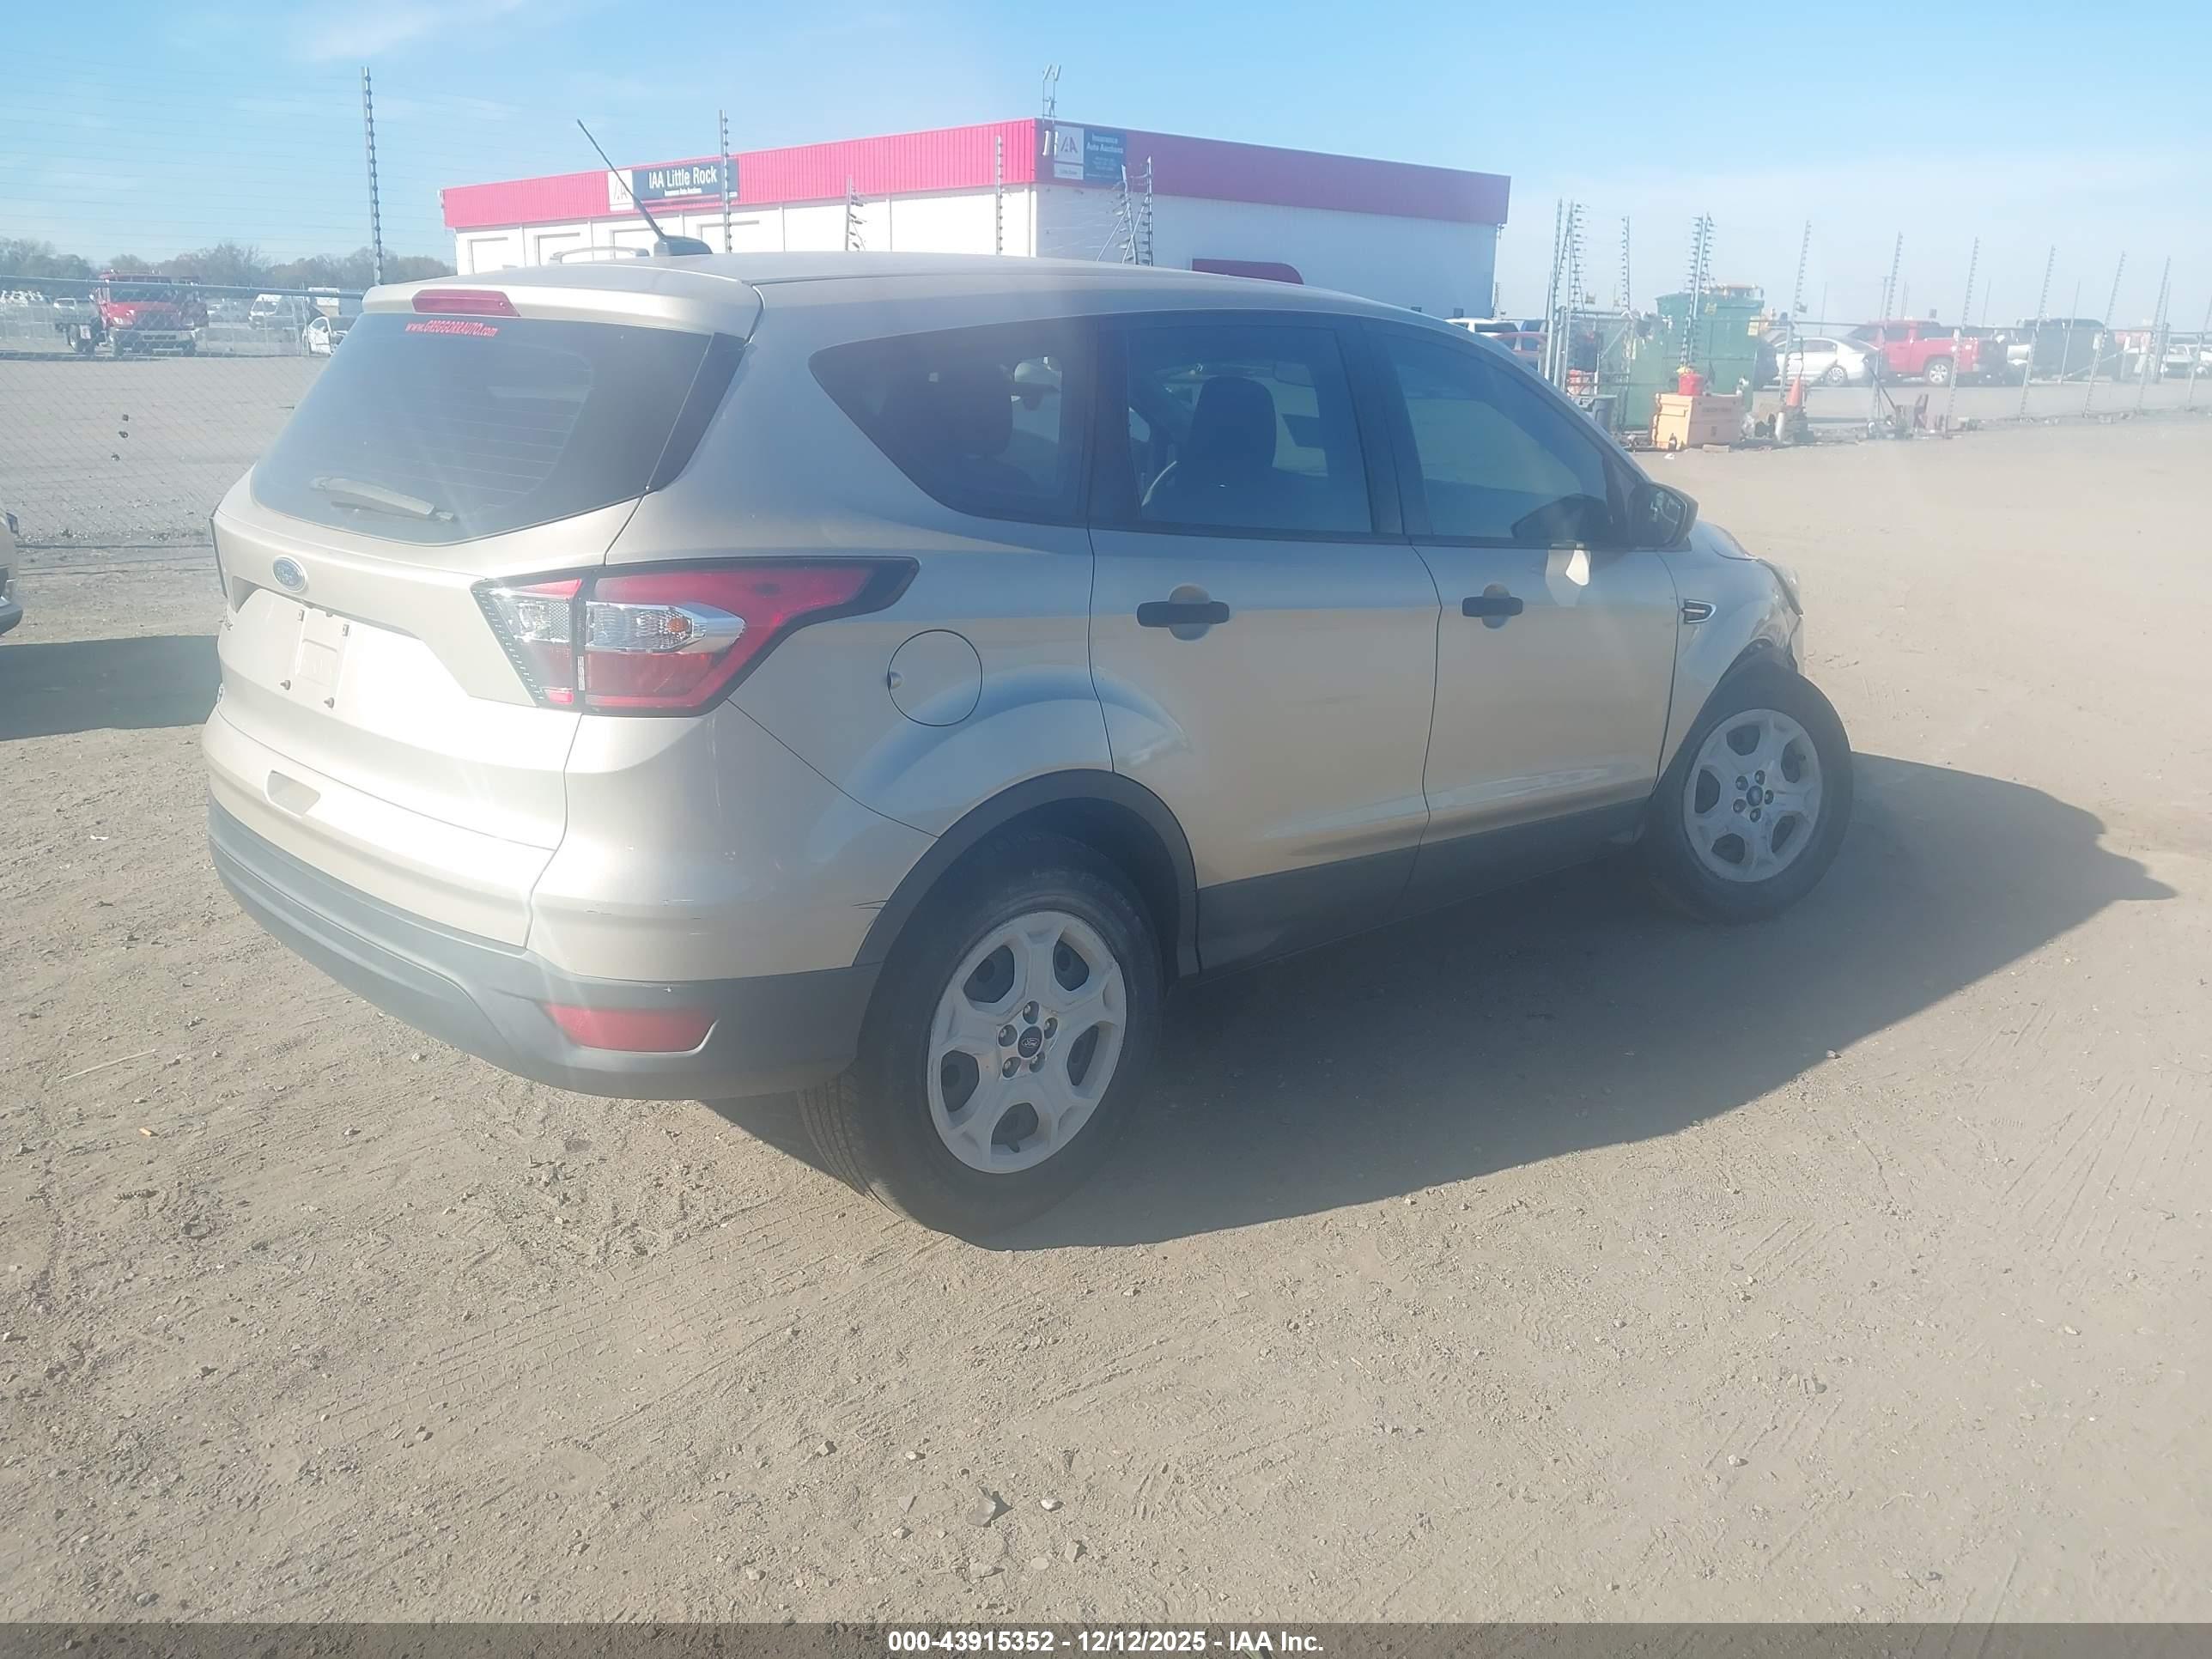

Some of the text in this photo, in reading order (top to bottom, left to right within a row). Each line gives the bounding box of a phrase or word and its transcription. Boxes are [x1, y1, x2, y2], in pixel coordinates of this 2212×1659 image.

[648, 165, 718, 189] IAA Little Rock
